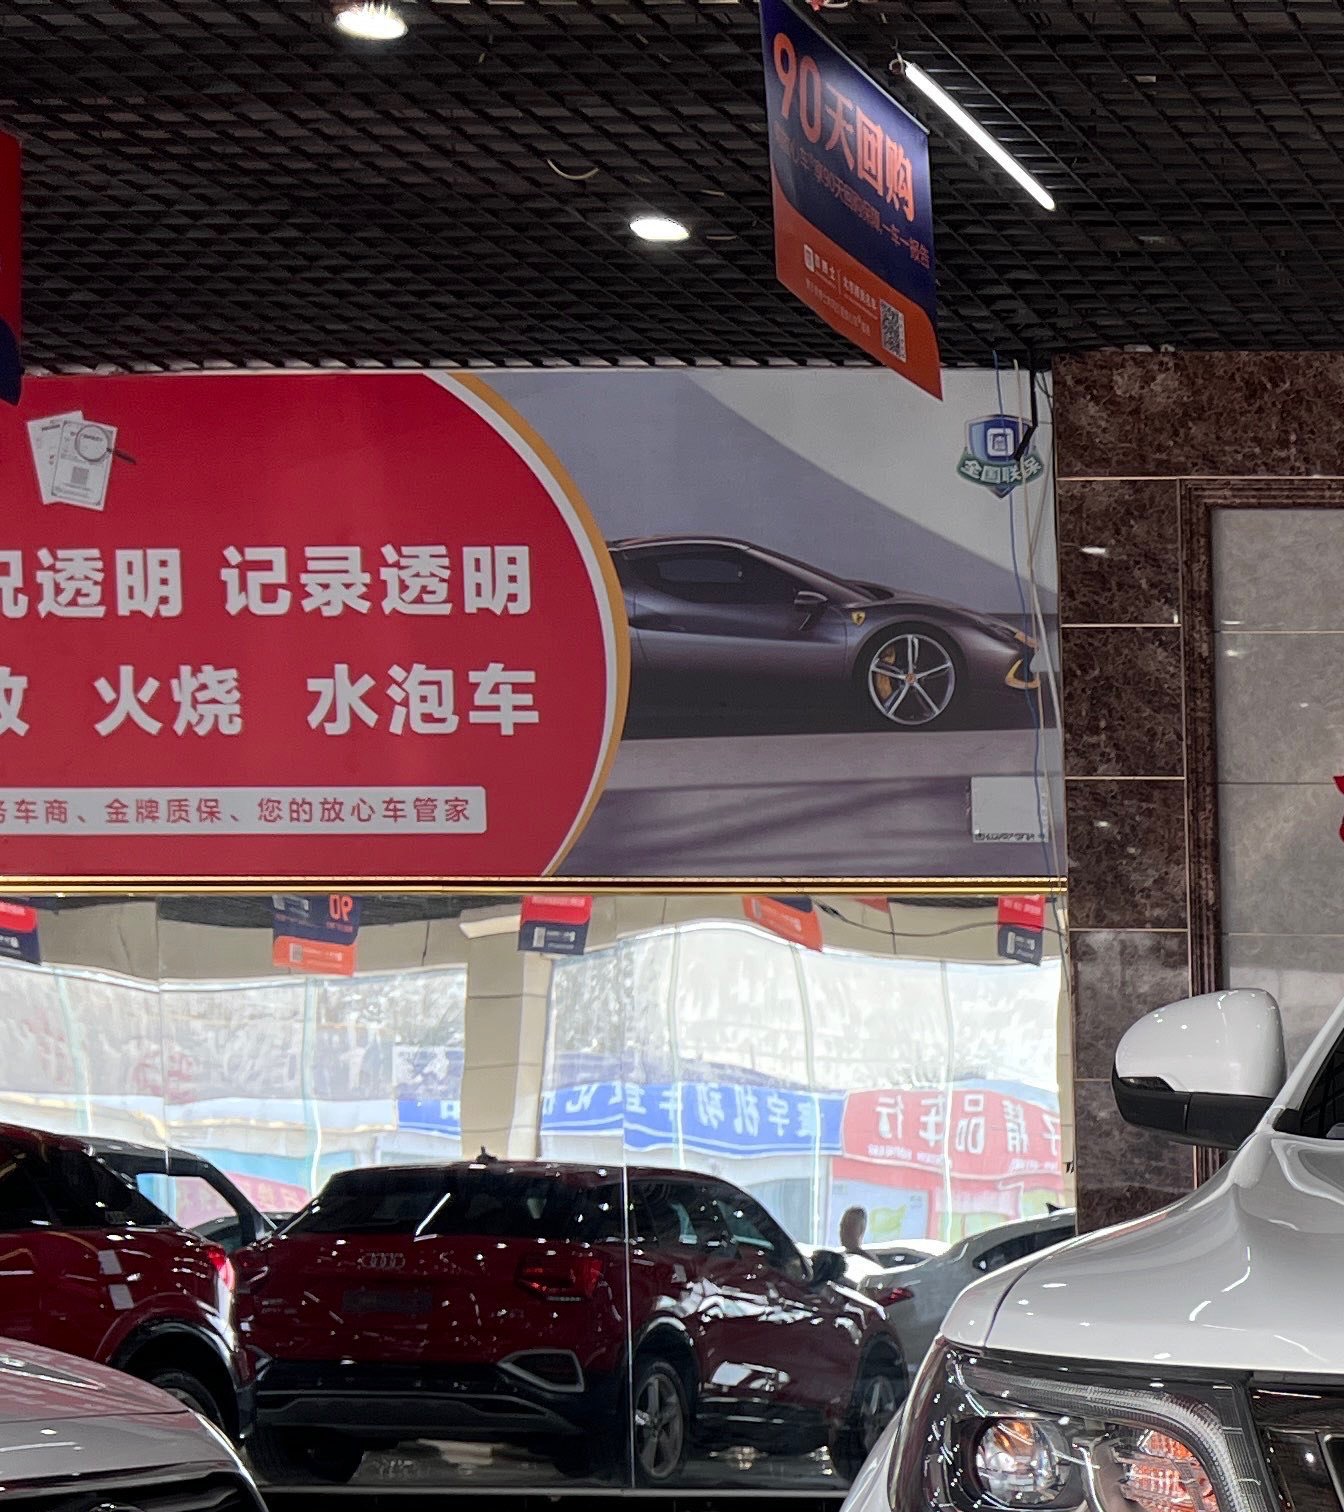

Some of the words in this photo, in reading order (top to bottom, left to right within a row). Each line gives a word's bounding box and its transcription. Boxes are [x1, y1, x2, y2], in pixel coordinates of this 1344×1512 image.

[773, 32, 915, 223] 90天回购
[220, 544, 532, 617] 记录透明
[93, 664, 243, 737] 火烧
[305, 662, 540, 737] 水泡车
[0, 797, 471, 826] 车商、金牌质保、您的放心车管家
